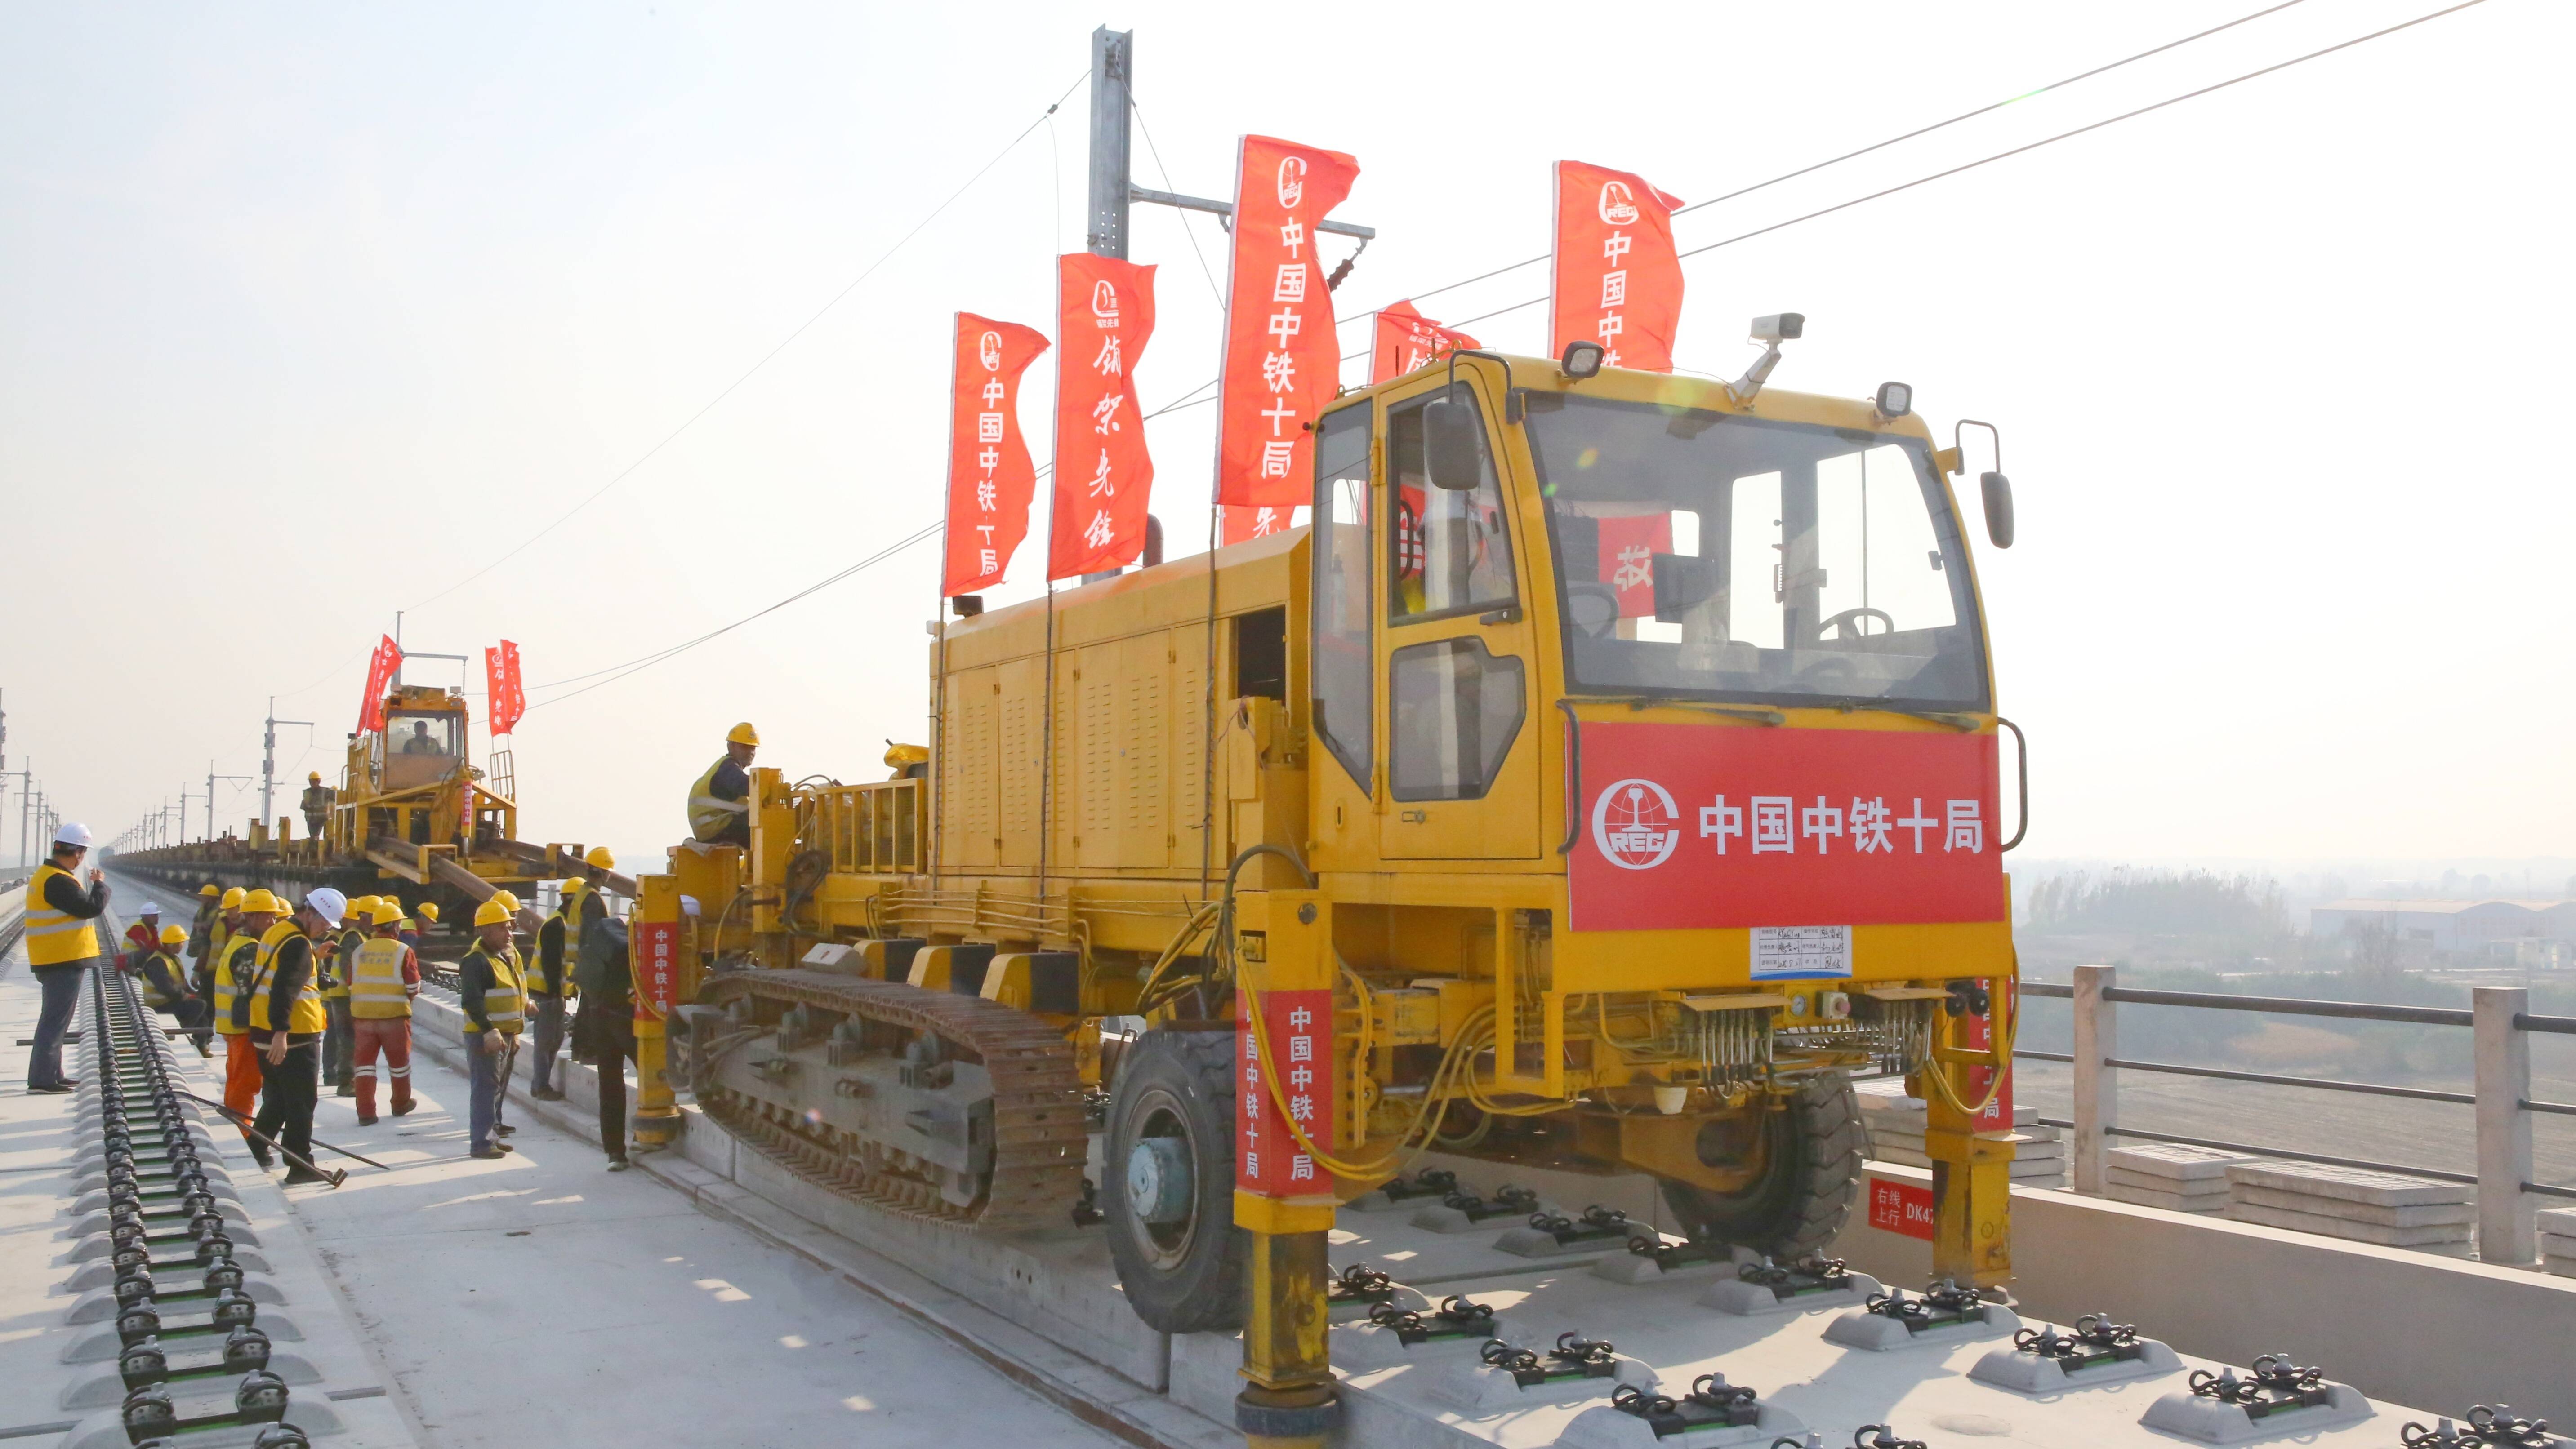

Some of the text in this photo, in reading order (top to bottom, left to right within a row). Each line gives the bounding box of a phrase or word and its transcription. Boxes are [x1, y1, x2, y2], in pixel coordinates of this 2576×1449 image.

[1261, 216, 1306, 479] 中国中铁十局
[977, 377, 1004, 578] 中国中铁十局
[1699, 794, 1983, 855] 中国中铁十局
[655, 929, 667, 1012] 中国中铁十局
[1876, 1208, 1900, 1226] 上行
[1877, 1188, 1901, 1208] 右线
